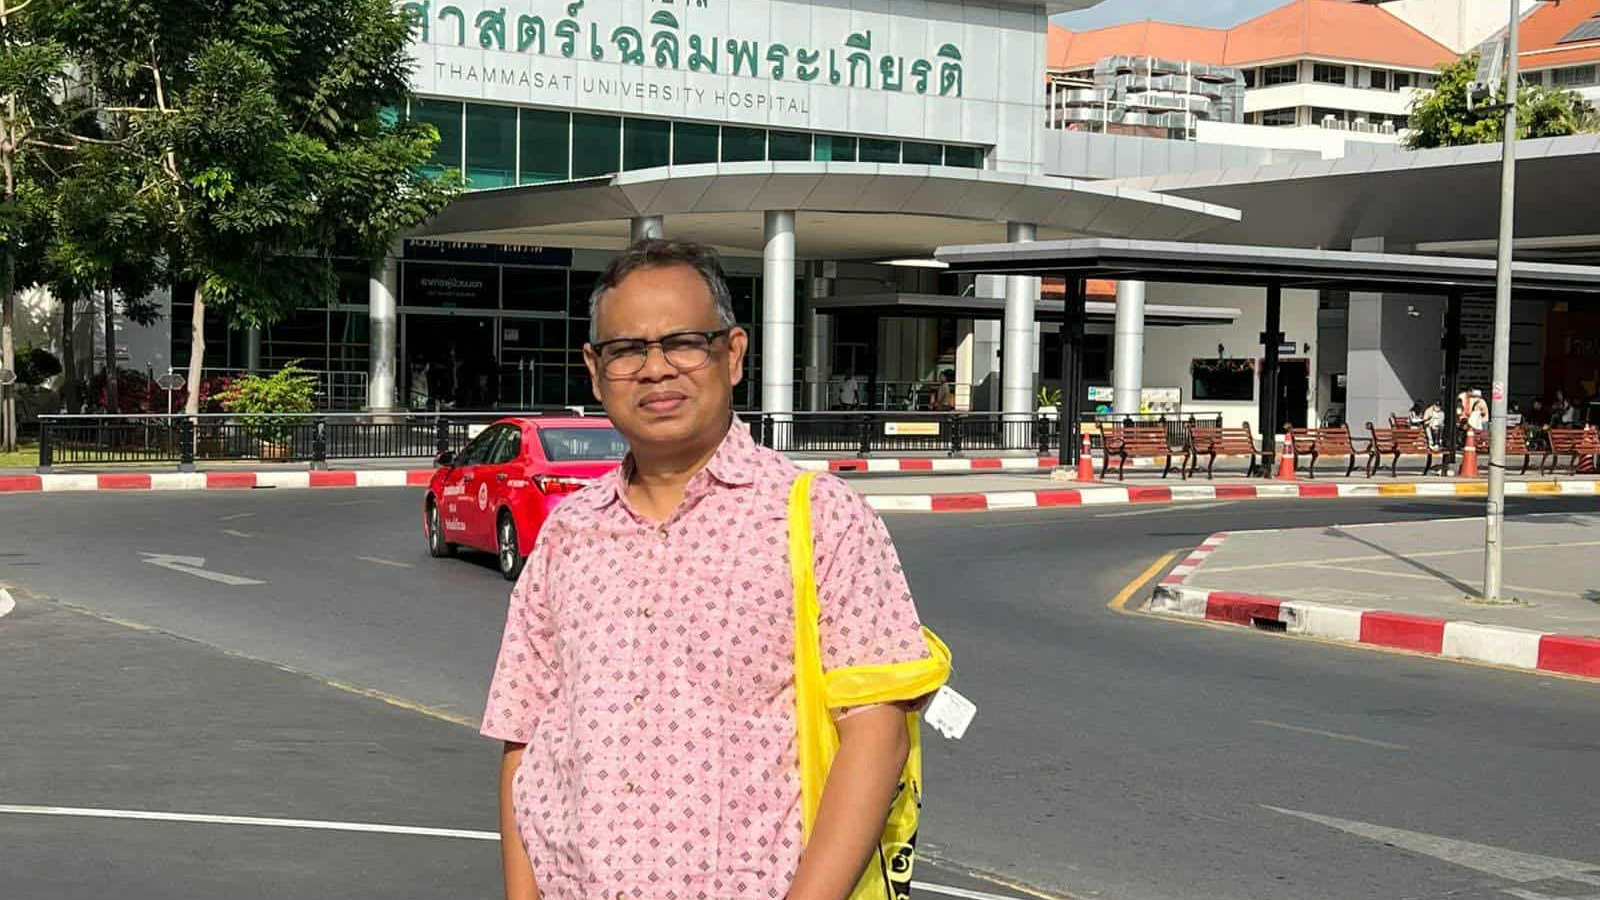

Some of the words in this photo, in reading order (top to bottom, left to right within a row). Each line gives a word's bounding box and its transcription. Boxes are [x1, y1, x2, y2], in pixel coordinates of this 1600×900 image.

[435, 62, 573, 91] THAMMASAT
[582, 77, 705, 104] UNIVERSITY
[715, 90, 809, 114] HOSPITAL
